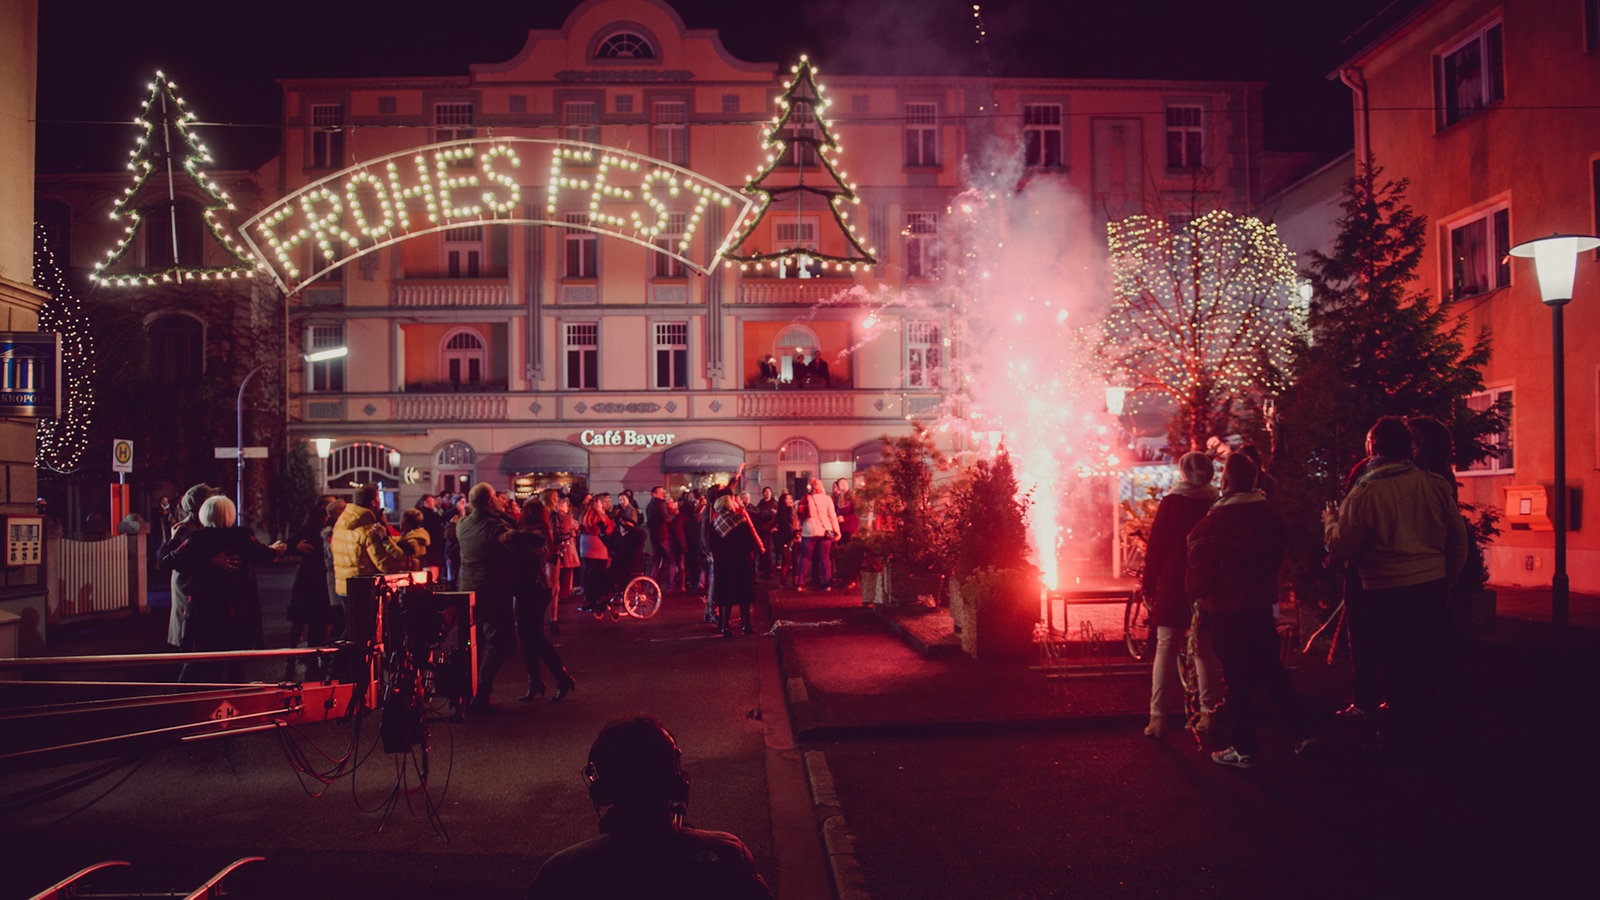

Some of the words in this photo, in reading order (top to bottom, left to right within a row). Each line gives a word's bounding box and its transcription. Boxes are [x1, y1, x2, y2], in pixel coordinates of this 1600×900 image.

[256, 144, 522, 278] FROHES
[546, 148, 732, 253] FEST
[581, 431, 621, 446] Café
[624, 431, 674, 448] Bayer
[119, 446, 127, 459] H
